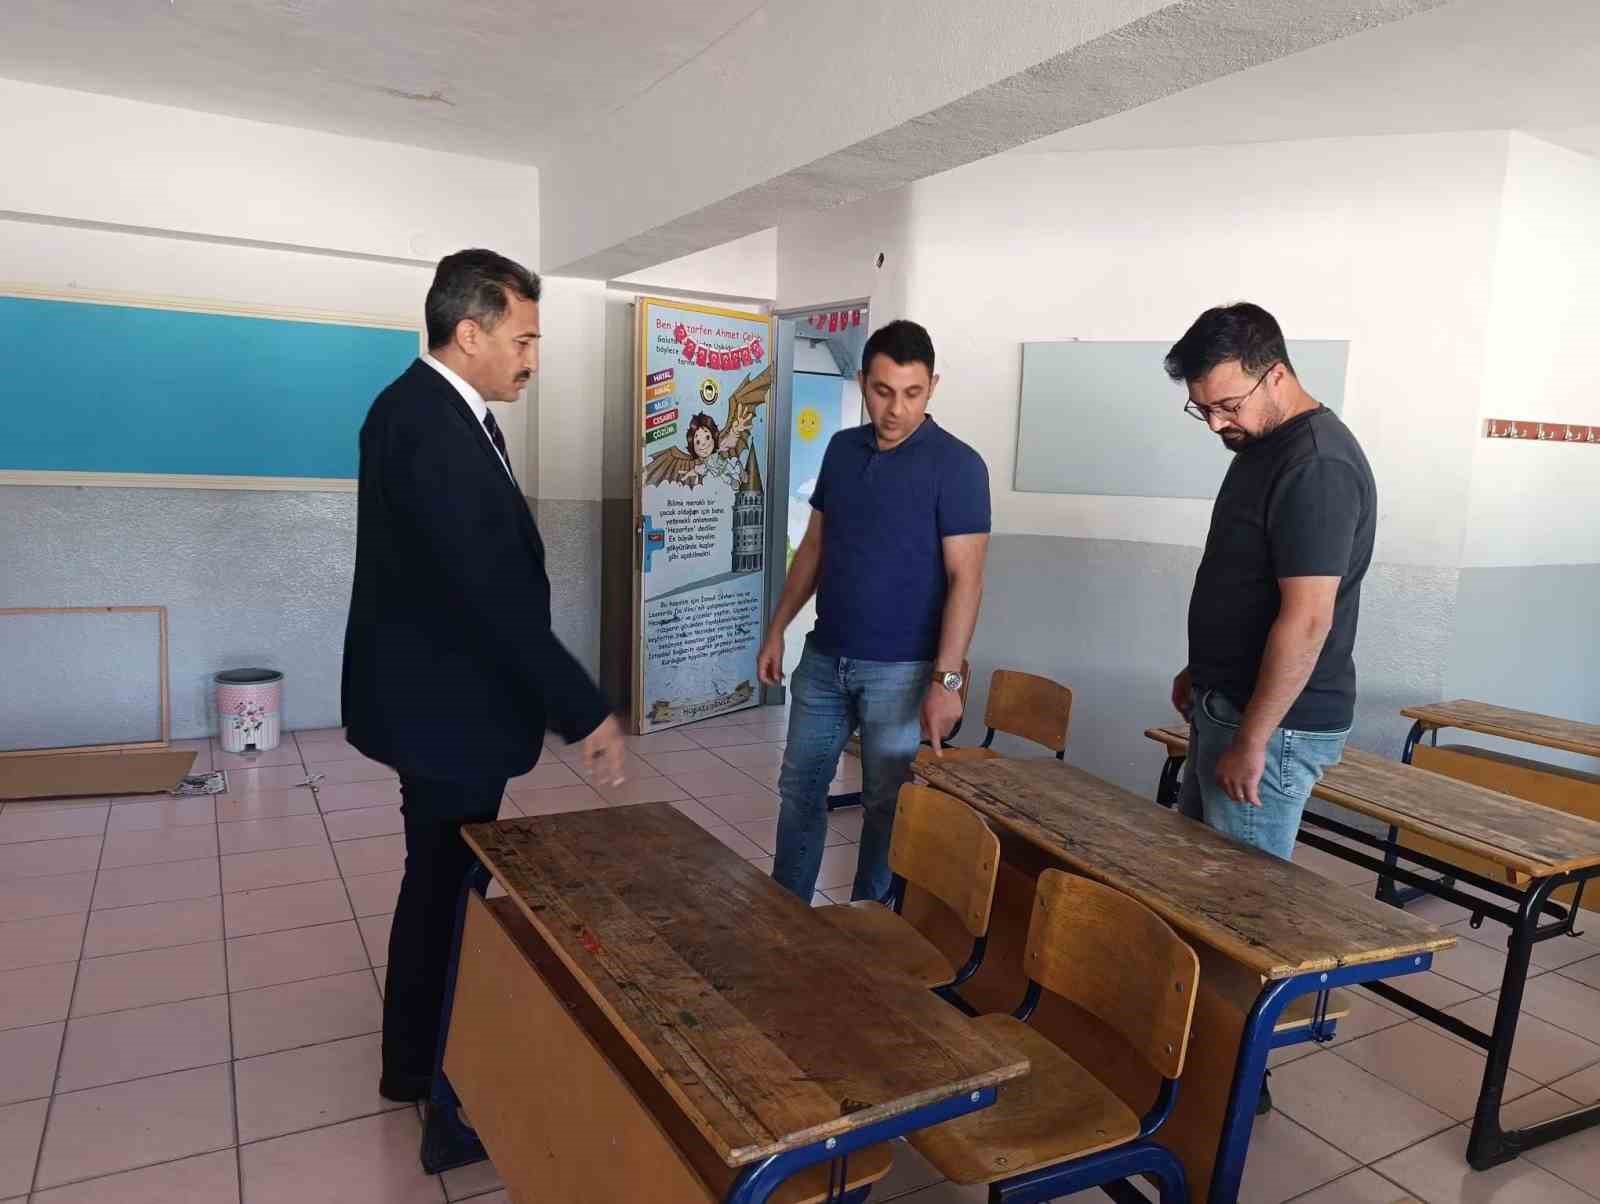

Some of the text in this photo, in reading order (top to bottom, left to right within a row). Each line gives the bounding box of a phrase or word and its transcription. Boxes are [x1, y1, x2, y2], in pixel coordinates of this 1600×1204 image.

[656, 318, 671, 329] Ben
[716, 328, 739, 340] Ahmet
[653, 370, 673, 381] HAYAL
[652, 425, 675, 440] ÇÖZÜM
